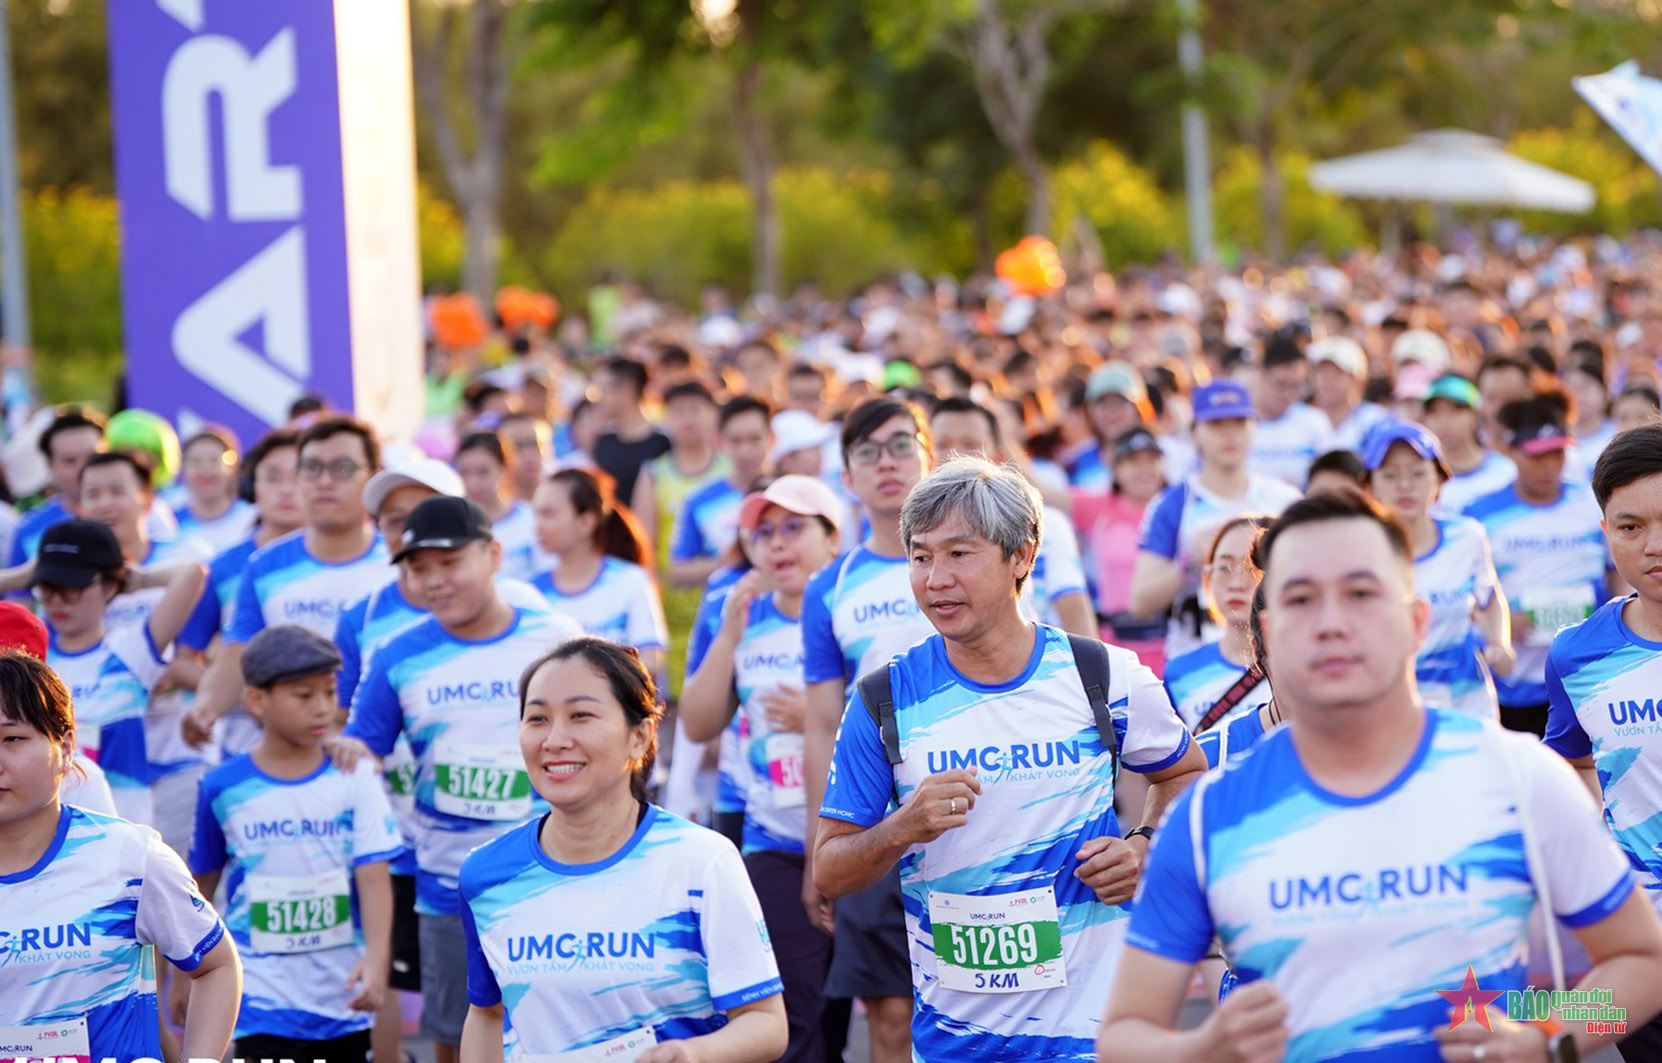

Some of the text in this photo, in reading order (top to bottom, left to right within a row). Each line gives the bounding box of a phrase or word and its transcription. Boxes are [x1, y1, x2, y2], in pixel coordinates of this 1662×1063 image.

[428, 681, 520, 704] UMC RU
[927, 740, 1081, 775] UMC RUN
[447, 765, 517, 800] 51427
[243, 819, 294, 840] UMC
[1269, 864, 1468, 910] UMC RUN
[266, 895, 337, 933] 51428
[989, 912, 1006, 920] RUN
[21, 922, 91, 951] RUN
[507, 932, 655, 962] UMC RUN
[950, 923, 1038, 966] 51269
[975, 972, 1020, 988] 5 KM
